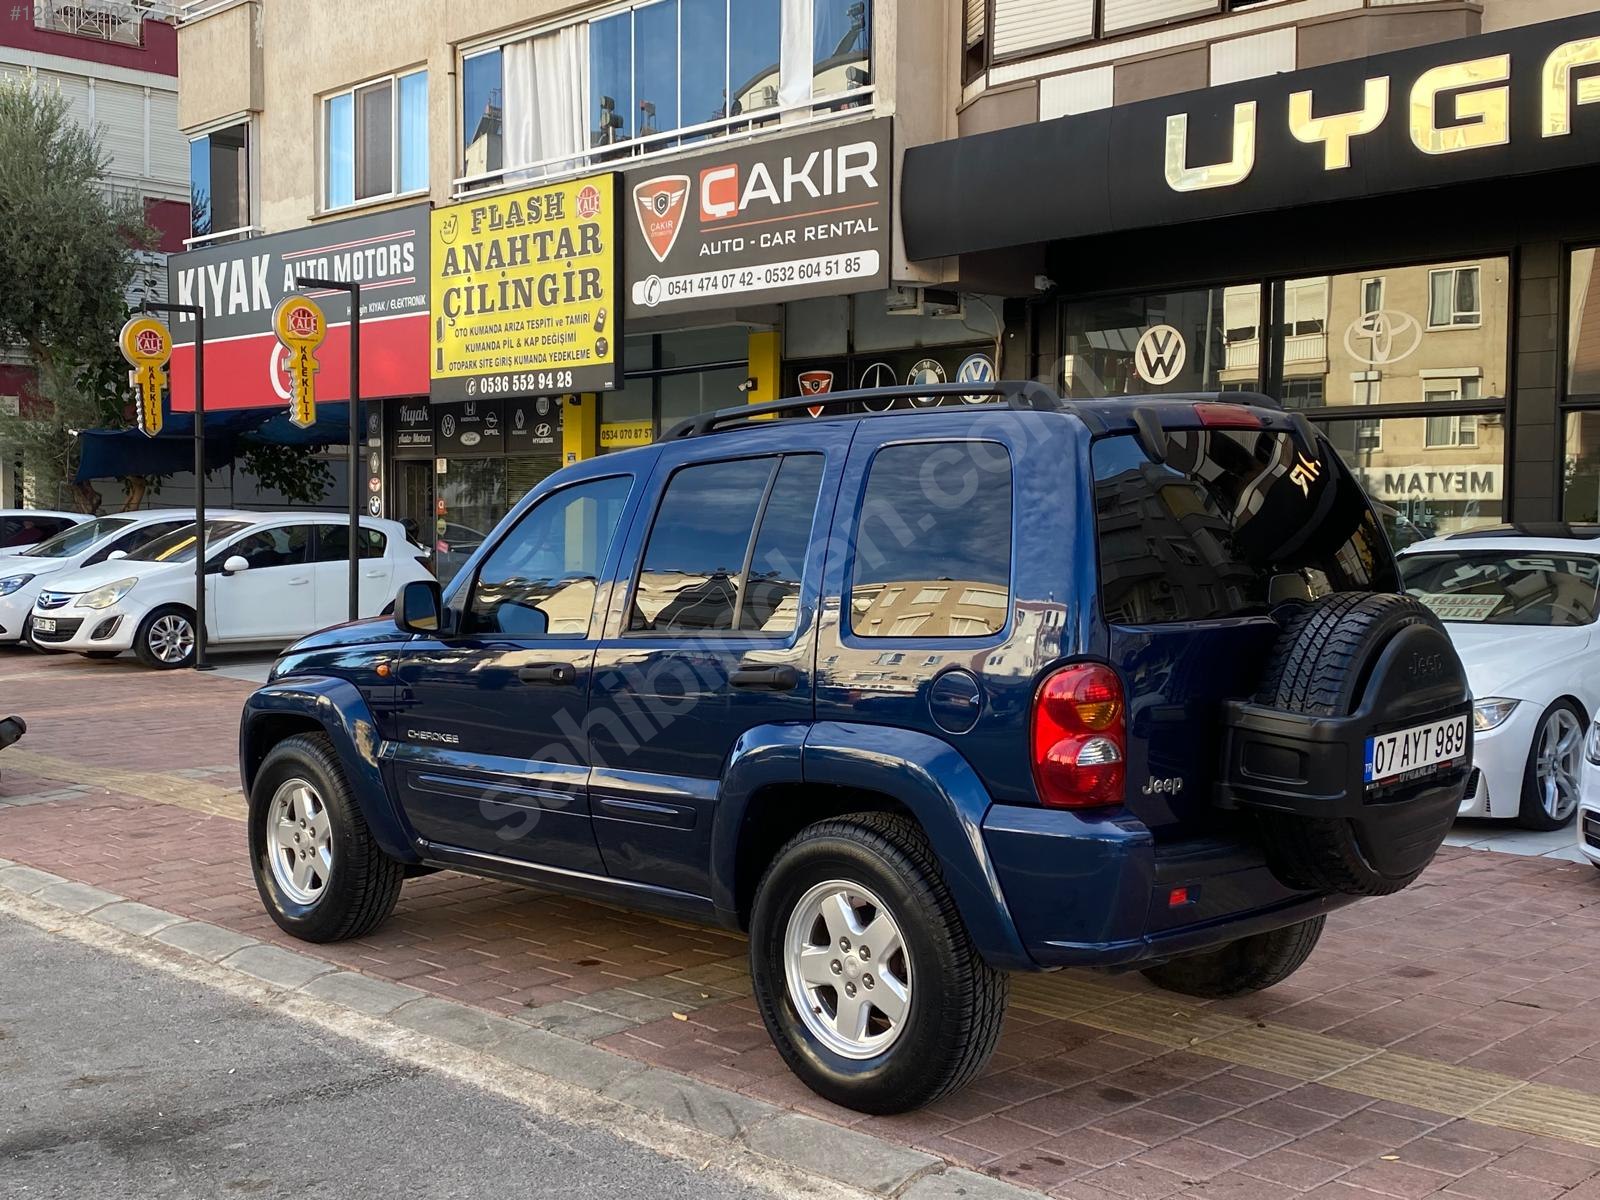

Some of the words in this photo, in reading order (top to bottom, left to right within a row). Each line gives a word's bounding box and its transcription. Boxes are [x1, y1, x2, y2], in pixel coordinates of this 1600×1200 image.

[701, 141, 879, 218] ÇAKIR
[470, 192, 565, 235] FLASH
[441, 222, 603, 278] ANAHTAR
[699, 238, 744, 256] AUTO
[760, 229, 797, 248] CAR
[804, 217, 879, 242] RENTAL
[283, 257, 328, 292] AUTO
[334, 241, 415, 283] MOTORS
[668, 281, 693, 296] 0541
[698, 277, 718, 294] 474
[721, 274, 736, 290] 07
[739, 271, 753, 287] 42
[765, 265, 794, 284] 0532
[798, 261, 820, 279] 604
[825, 259, 839, 276] 51
[845, 256, 861, 273] 85
[178, 254, 272, 323] KIYAK
[443, 260, 604, 327] ÇİLİNGİR
[455, 328, 468, 338] OTO
[469, 325, 503, 337] KUMANDA
[504, 321, 525, 333] ARIZA
[555, 318, 563, 327] ve
[465, 341, 501, 353] KUMANDA
[516, 338, 521, 348] &
[524, 336, 539, 347] KAP
[449, 361, 478, 372] OTOPARK
[514, 353, 547, 365] KUMANDA
[549, 348, 591, 363] YEDEKLEME
[480, 375, 509, 394] 0536
[512, 373, 535, 392] 552
[538, 372, 553, 389] 94
[557, 370, 573, 388] 28
[601, 429, 618, 440] 0534
[619, 428, 632, 439] 070
[634, 428, 643, 438] 87
[644, 427, 653, 438] 57
[407, 729, 460, 744] CHEROKEE
[1375, 737, 1397, 774] 07
[1400, 728, 1432, 768] AYT
[1435, 721, 1464, 758] 989
[1142, 775, 1184, 796] Jeep
